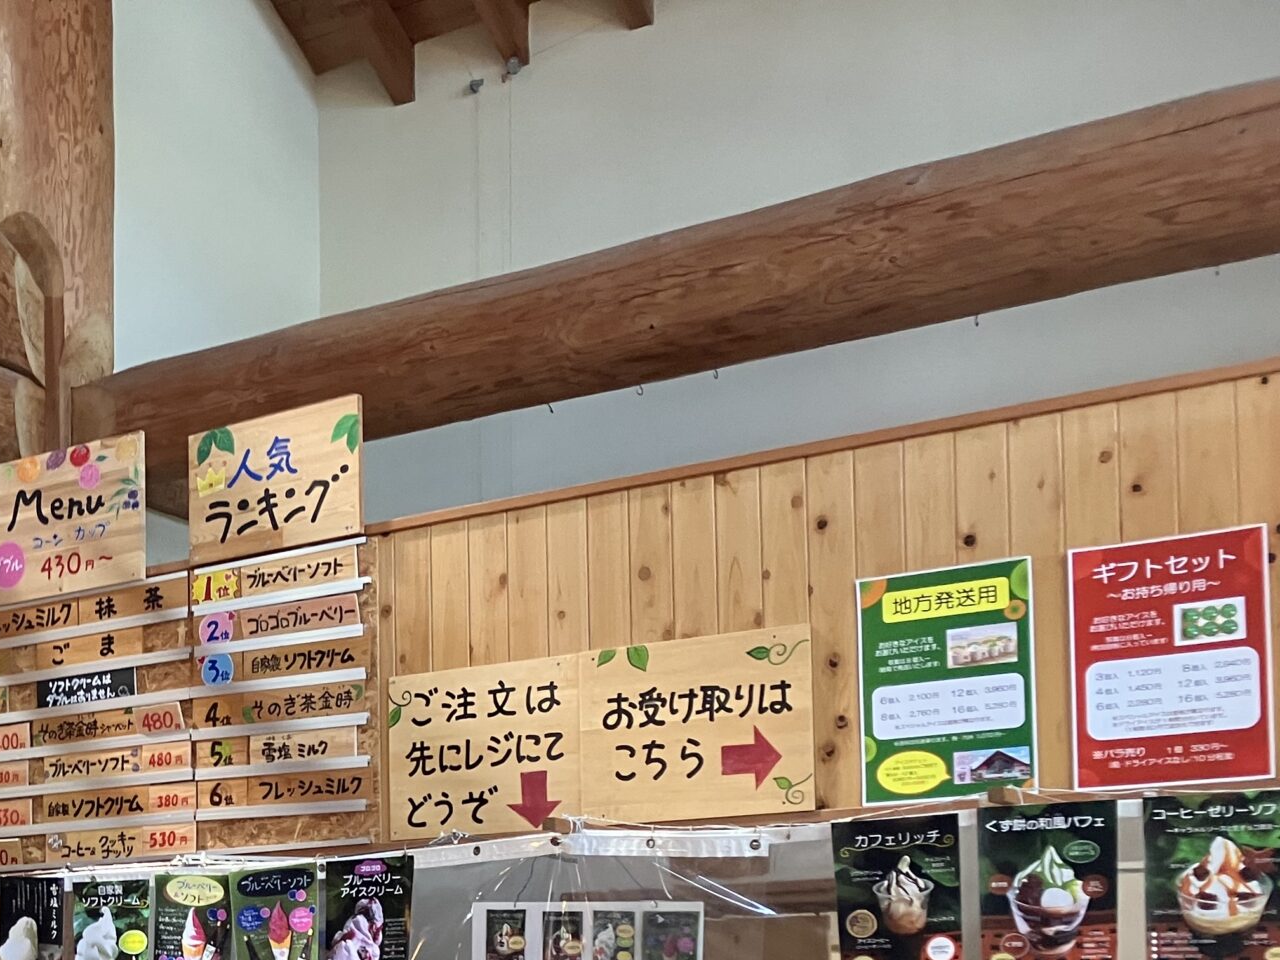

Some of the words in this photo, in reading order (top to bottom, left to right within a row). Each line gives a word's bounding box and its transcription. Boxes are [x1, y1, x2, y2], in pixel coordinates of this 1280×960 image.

[227, 436, 298, 488] 人気
[8, 490, 104, 530] Menu
[206, 464, 350, 543] ランキング
[33, 534, 63, 550] コーン
[75, 522, 108, 539] カップ
[204, 576, 230, 601] 1位
[247, 558, 343, 589] ブルーベリーソフト
[1092, 549, 1236, 584] ギフトセット
[95, 586, 163, 620] 抹茶
[893, 584, 997, 615] 地方発送用
[207, 621, 230, 642] 2位
[247, 606, 355, 635] ゴロゴロブルーベリー
[52, 634, 115, 666] ごま
[208, 660, 230, 683] 3位
[284, 648, 354, 670] ソフトクリーム
[46, 687, 115, 707] ダブルはありません
[49, 673, 111, 693] ソフトクリームは
[205, 702, 232, 727] 4位
[252, 689, 354, 719] そのぎ茶金時
[410, 680, 560, 727] ご注文は
[602, 680, 792, 730] お受け取りは
[143, 711, 181, 732] 480円
[49, 753, 130, 778] ブルーベリーソフト
[149, 752, 183, 767] 480円
[210, 741, 233, 767] 5位
[298, 740, 328, 756] ミルク
[405, 731, 564, 777] 先にレジにて
[614, 738, 704, 781] こちら
[72, 796, 144, 817] ソフトクリーム
[157, 795, 189, 808] 380円
[210, 782, 234, 806] 6位
[259, 777, 362, 800] フレッシュミルク
[407, 784, 498, 827] どうぞ
[149, 831, 187, 848] 530円
[855, 830, 940, 848] カフェリッチ
[98, 885, 123, 895] 自家製
[241, 875, 311, 891] ブルーベリーソフト
[341, 885, 403, 897] アイスクリーム
[343, 873, 401, 886] ブルーベリー
[83, 896, 140, 907] ソフトクリーム
